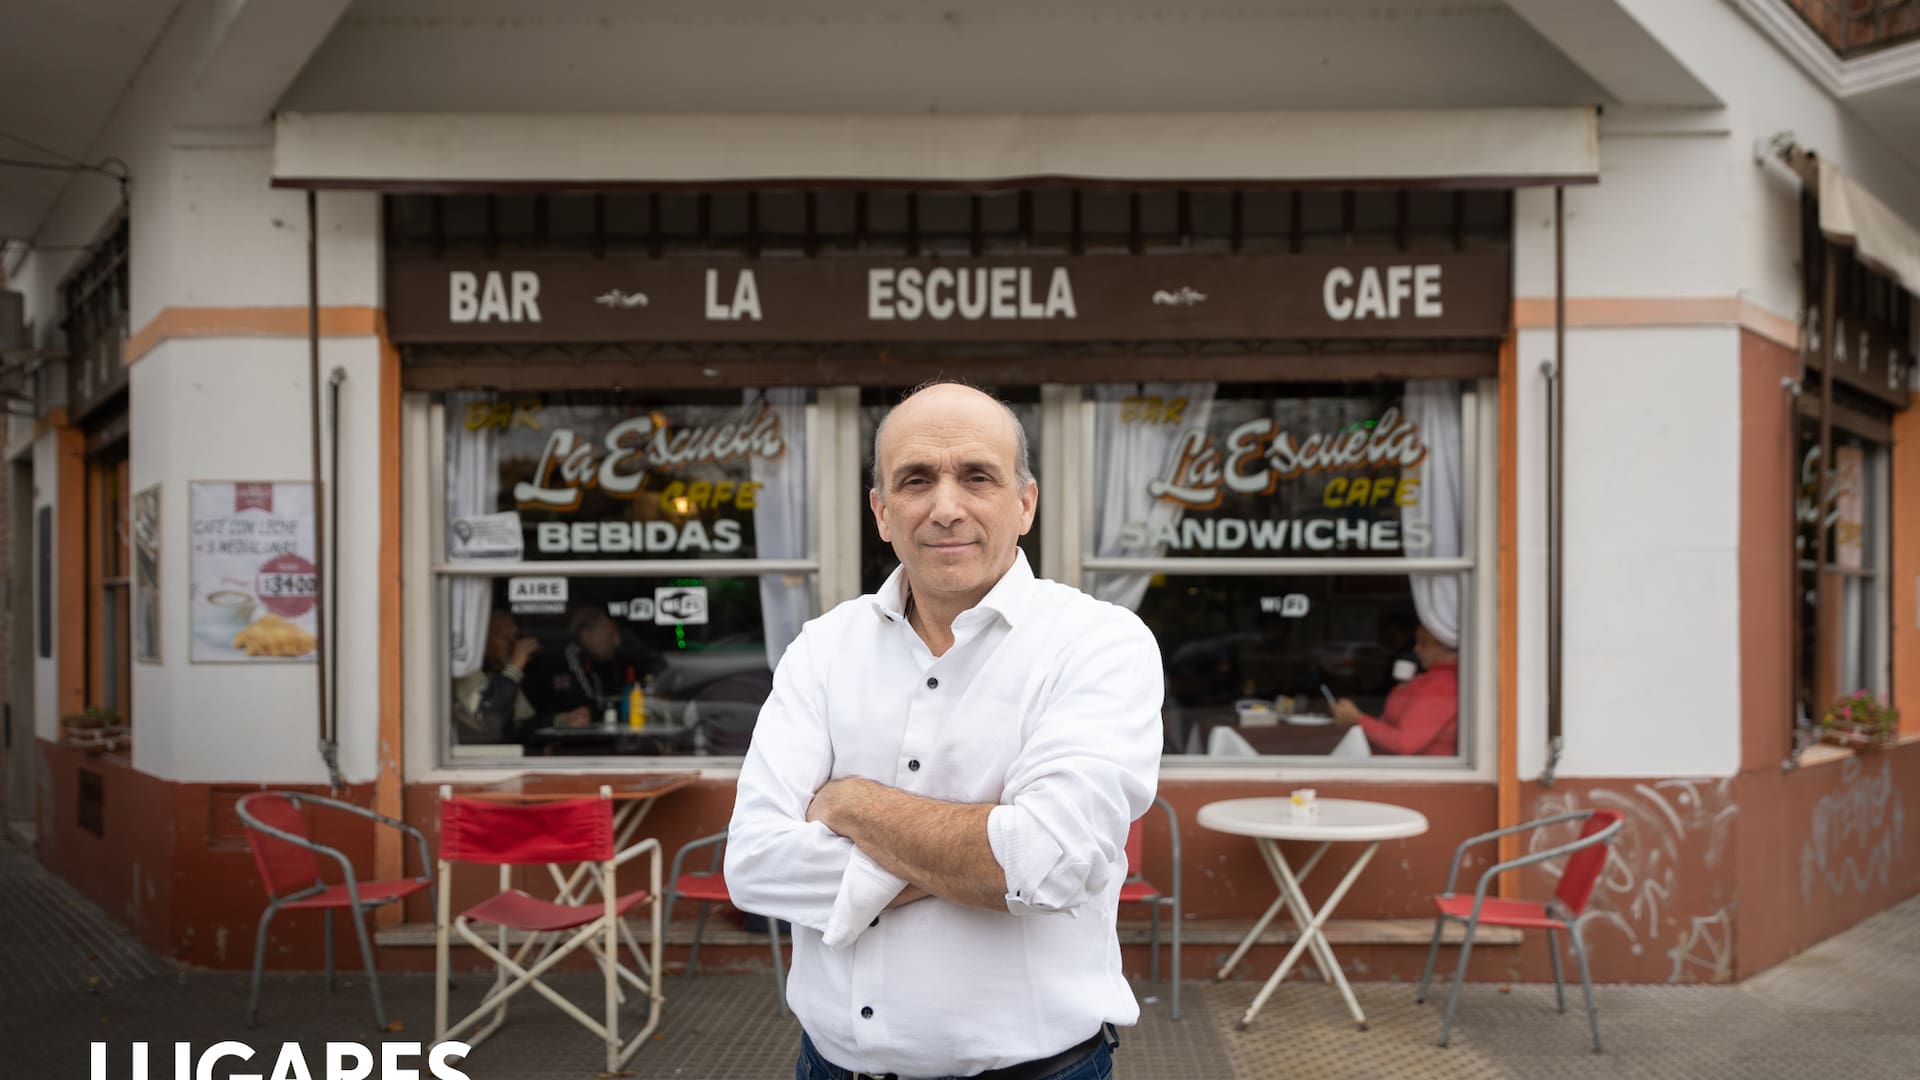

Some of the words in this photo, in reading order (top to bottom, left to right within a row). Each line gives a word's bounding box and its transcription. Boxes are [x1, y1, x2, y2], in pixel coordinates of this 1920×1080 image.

[450, 270, 542, 322] BAR
[705, 268, 763, 320] LA
[868, 267, 1077, 319] ESCUELA
[1323, 265, 1443, 320] CAFE
[464, 401, 542, 431] BAR
[1119, 396, 1188, 426] BAR
[514, 429, 597, 511] La
[600, 399, 786, 498] Escuela
[1150, 428, 1222, 509] La
[1224, 407, 1427, 495] Escuela
[660, 481, 764, 511] CAFE
[1324, 478, 1421, 508] CAFE
[537, 520, 742, 553] BEBIDAS
[1122, 518, 1432, 550] SANDWICHES
[516, 583, 560, 595] AIRE
